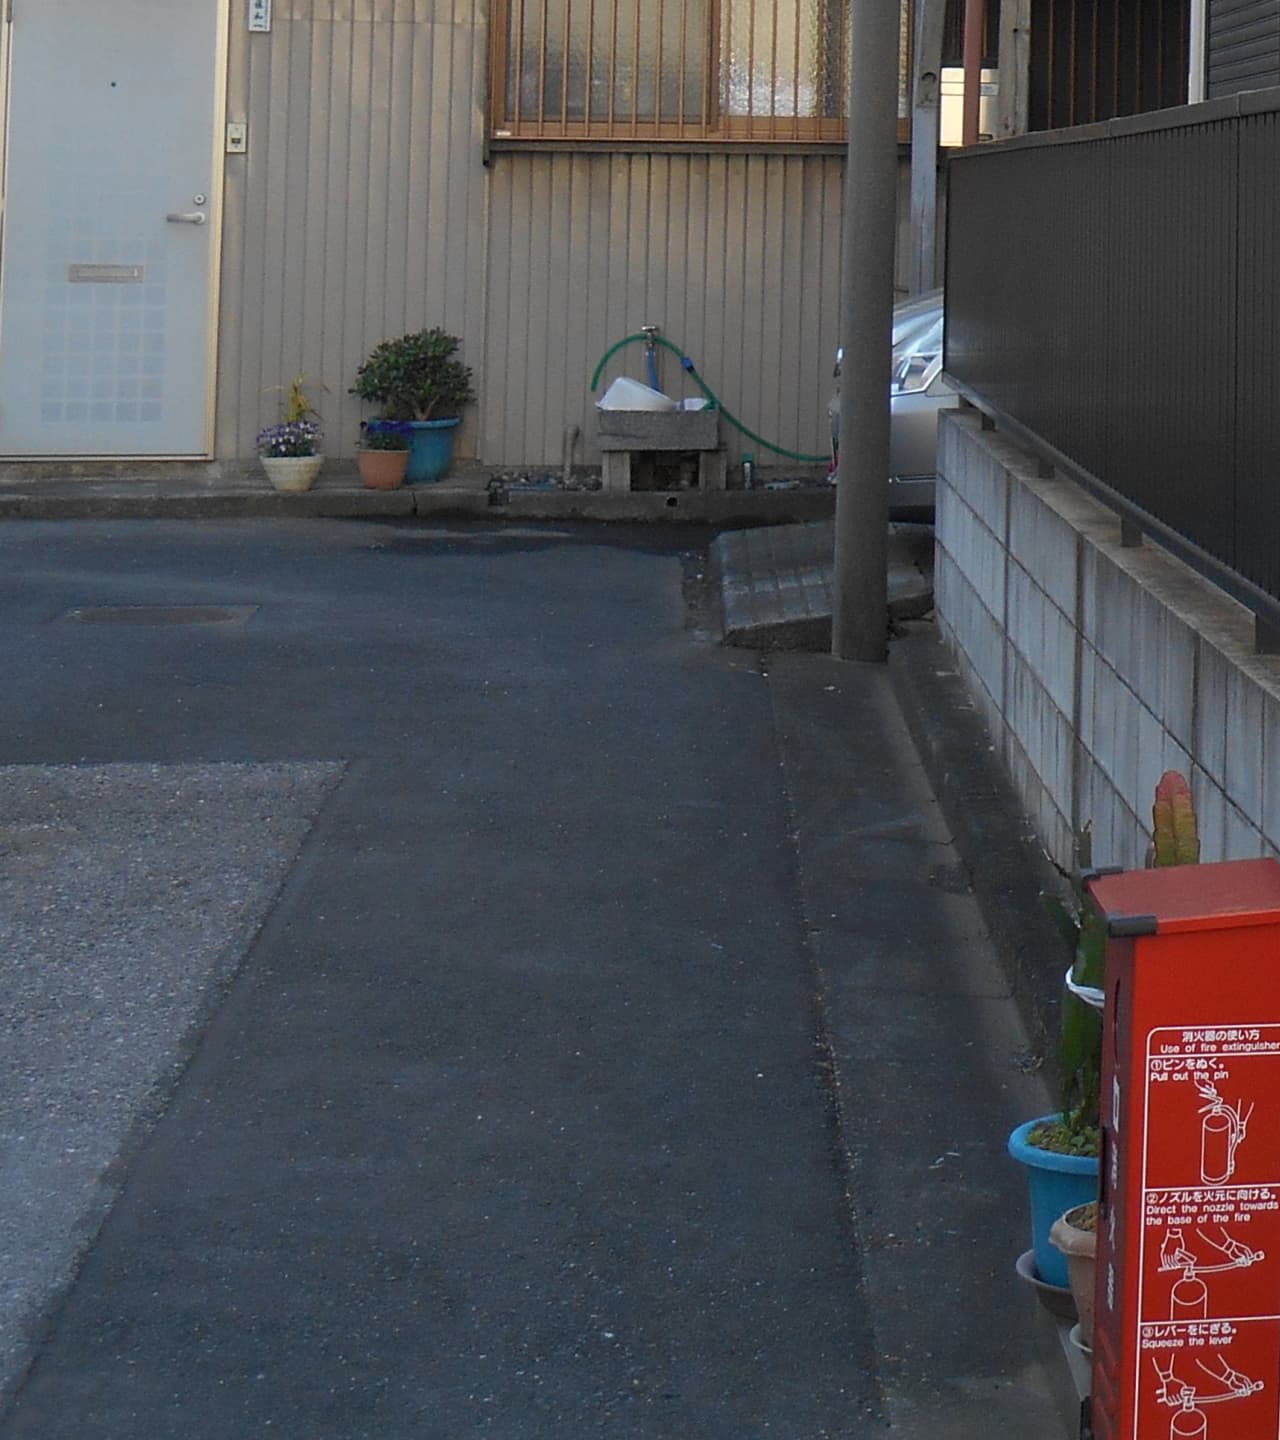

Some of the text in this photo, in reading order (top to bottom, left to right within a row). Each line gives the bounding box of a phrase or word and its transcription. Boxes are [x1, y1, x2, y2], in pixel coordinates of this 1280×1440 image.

[1182, 1029, 1260, 1042] 消火器の使い方
[1160, 1041, 1280, 1053] Use of fire extinguisher
[1150, 1070, 1229, 1081] Pull out the pin
[1146, 1200, 1279, 1215] Direct the nozzle towards
[1146, 1212, 1250, 1225] the base of the fire
[1142, 1336, 1232, 1349] Squeeze the lever
